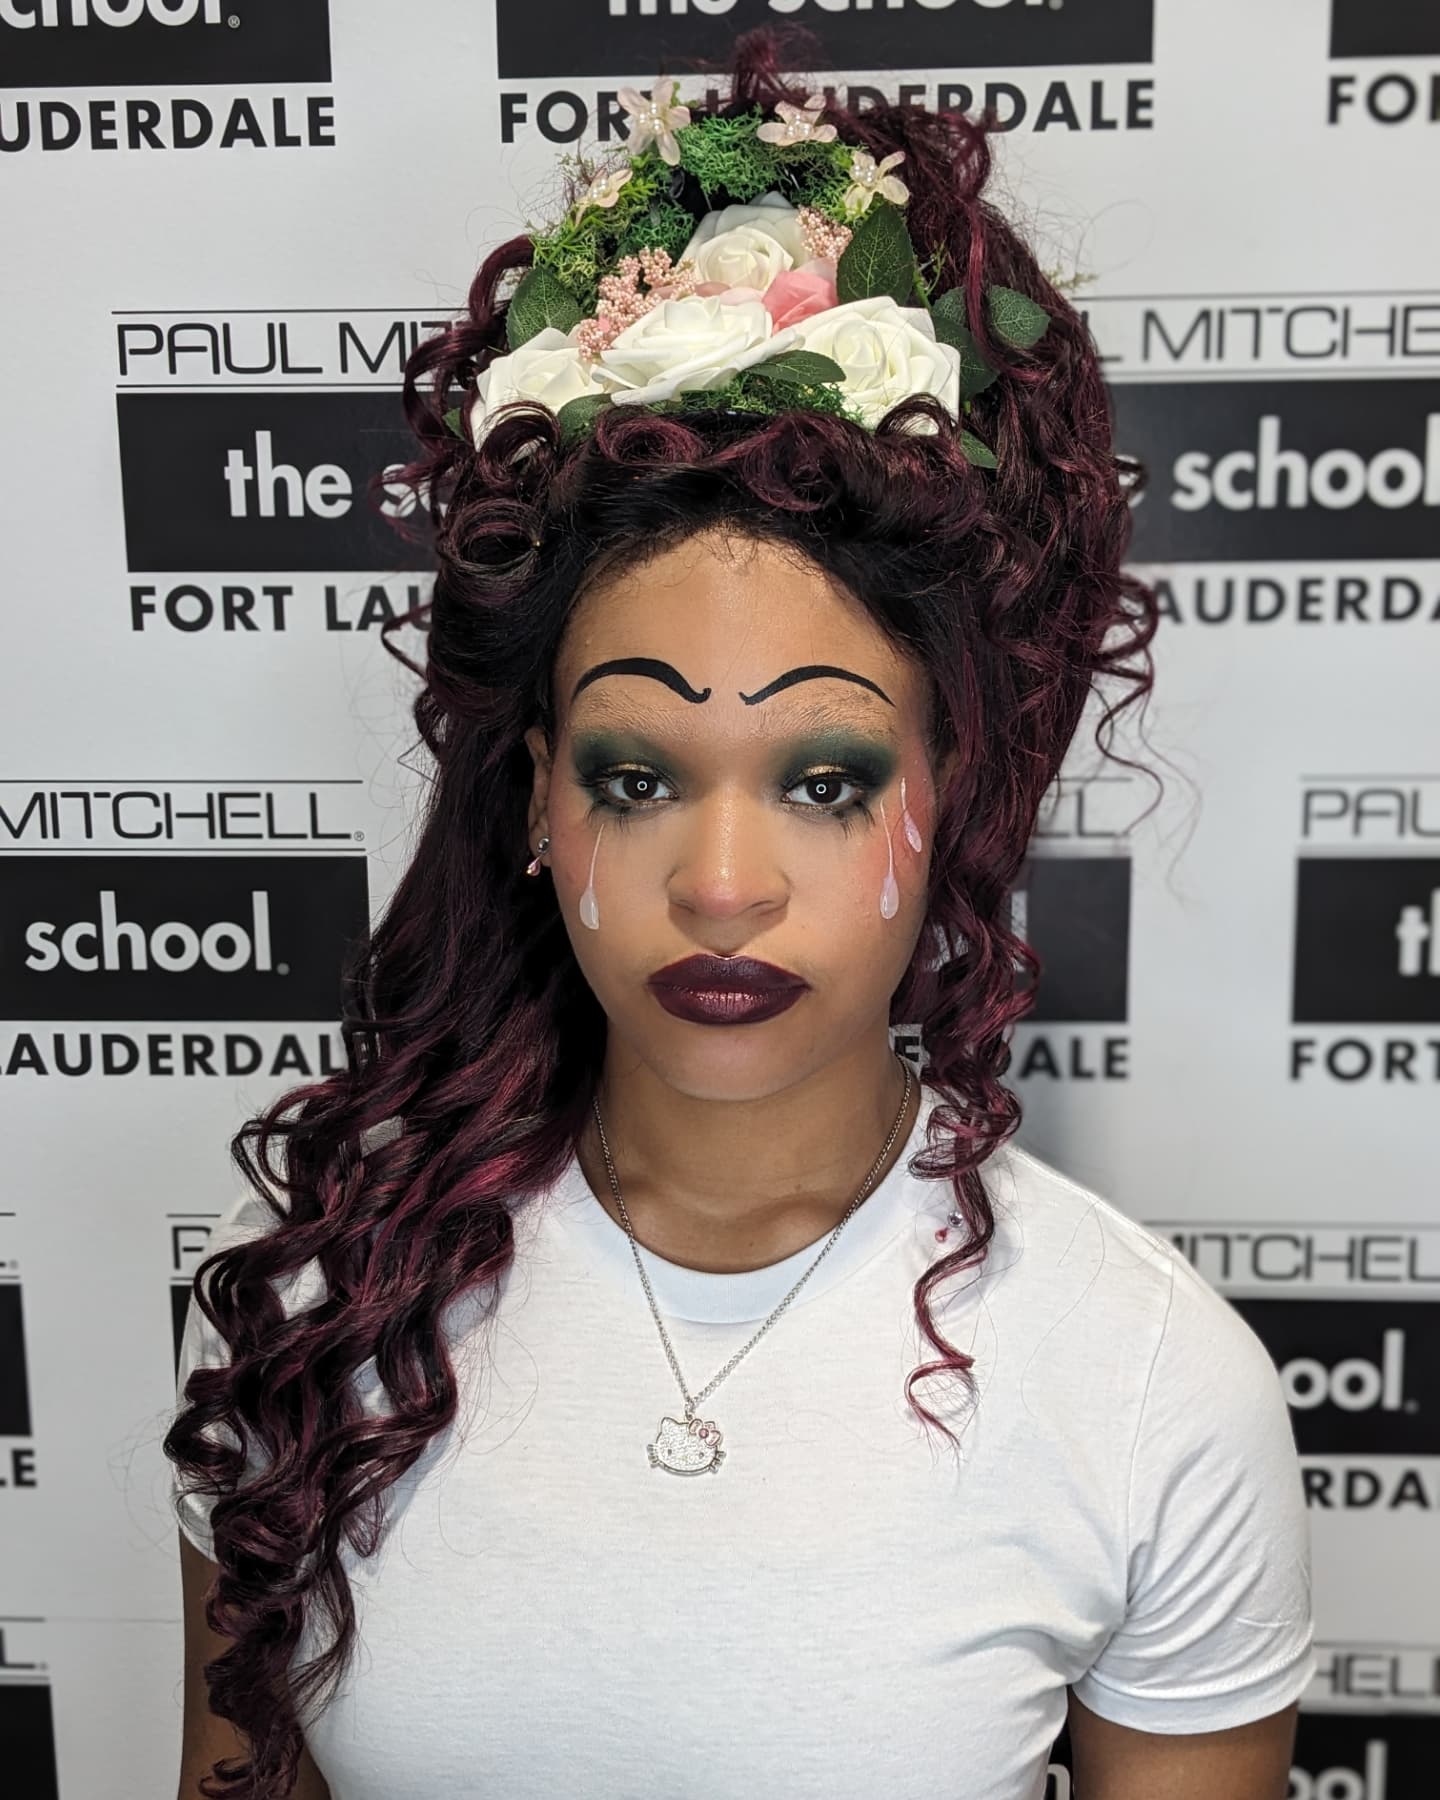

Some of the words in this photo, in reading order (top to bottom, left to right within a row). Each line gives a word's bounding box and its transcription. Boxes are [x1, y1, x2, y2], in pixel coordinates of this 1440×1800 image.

[0, 97, 336, 152] UDERDALE
[500, 90, 652, 143] FOR
[117, 323, 323, 376] PAUL
[224, 430, 352, 519] the
[130, 584, 293, 632] FORT
[1150, 576, 1440, 625] AUDERD
[0, 1033, 349, 1077] AUDERDAL
